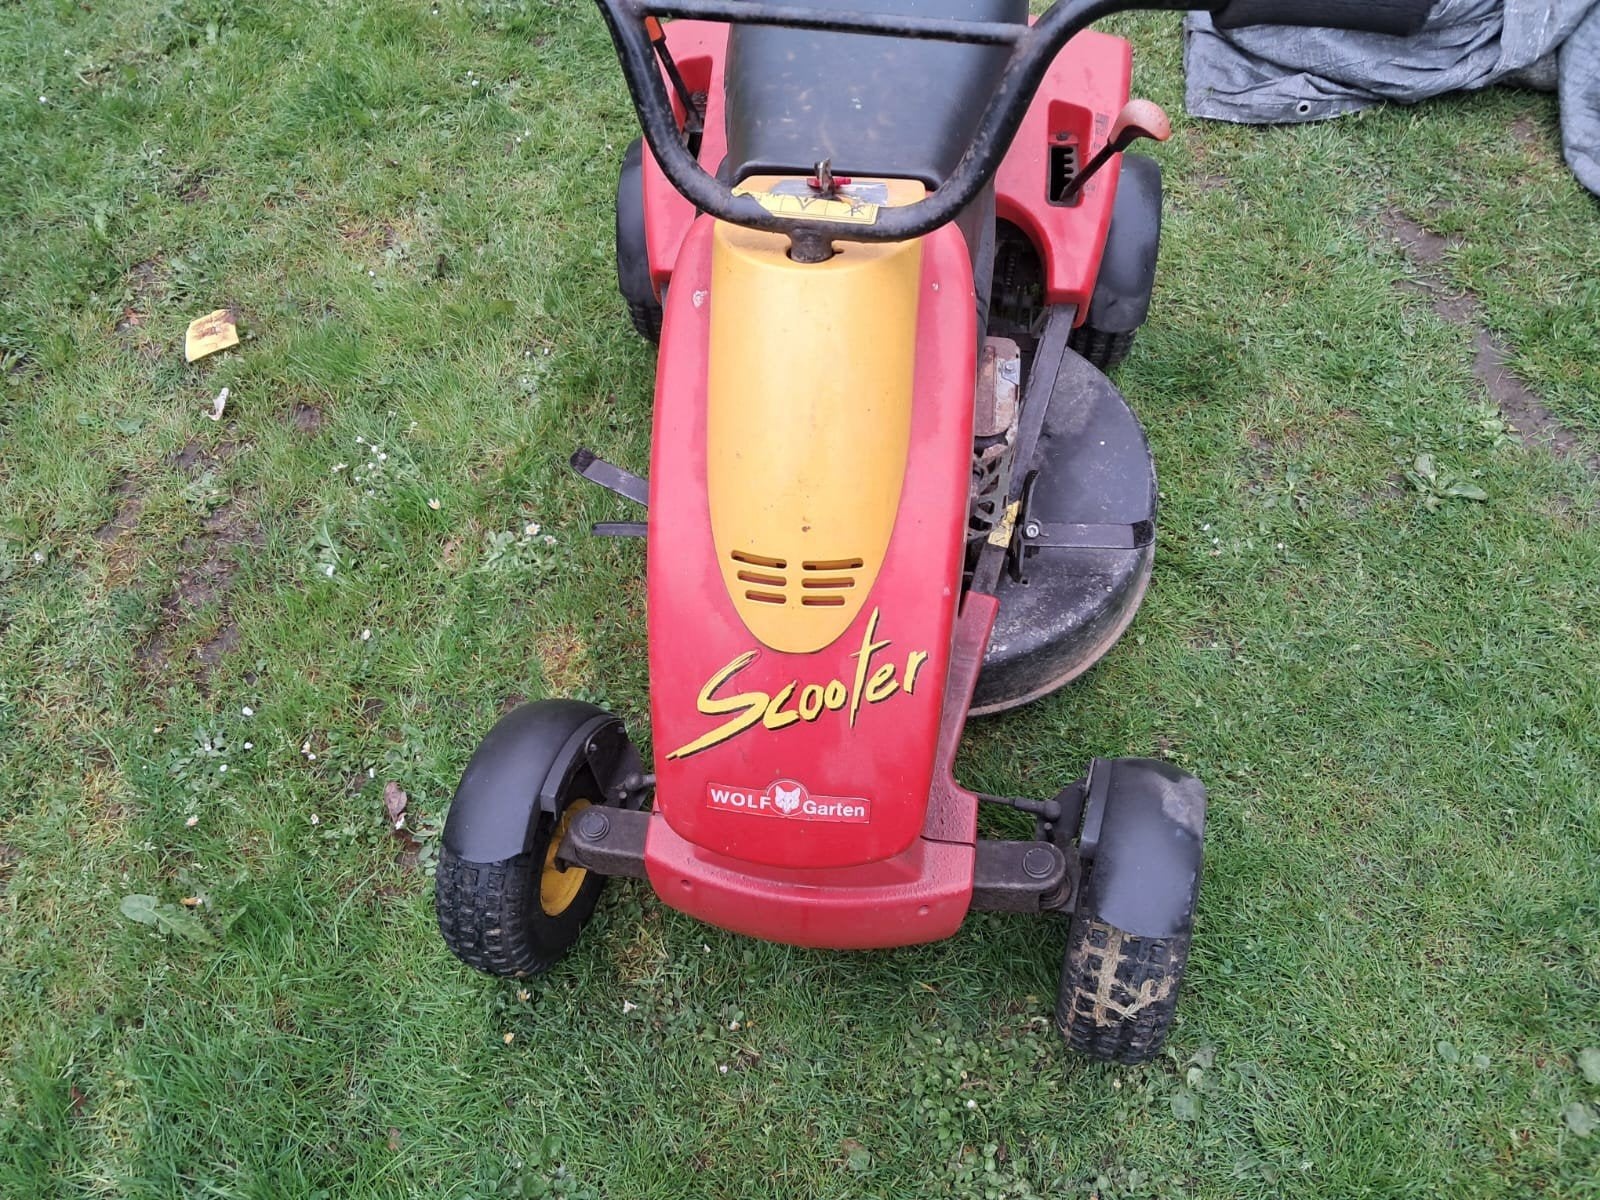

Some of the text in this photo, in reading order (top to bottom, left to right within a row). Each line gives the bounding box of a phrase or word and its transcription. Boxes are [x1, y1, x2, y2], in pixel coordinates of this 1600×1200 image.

[665, 606, 928, 760] Scooter
[710, 788, 865, 817] WOLF Garten
